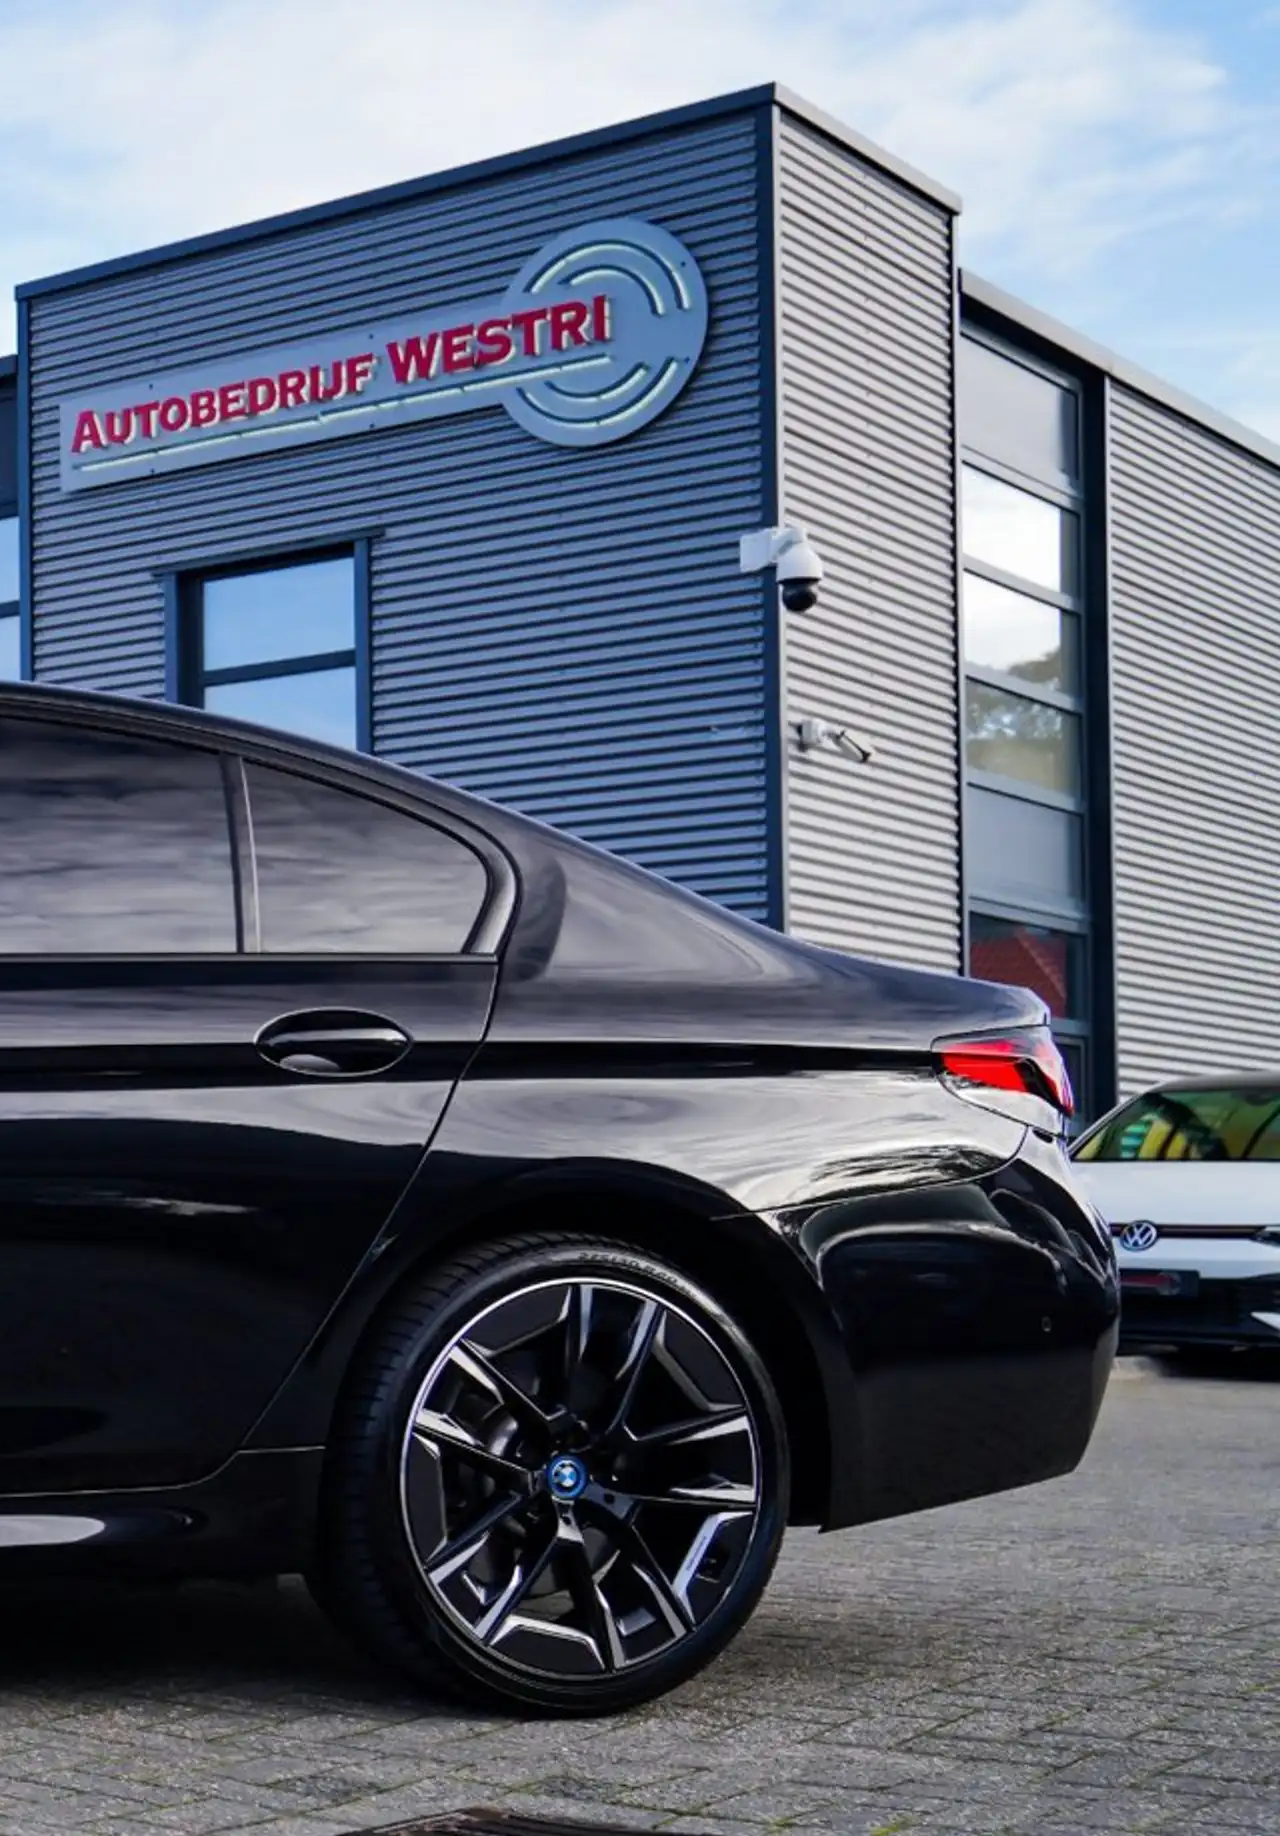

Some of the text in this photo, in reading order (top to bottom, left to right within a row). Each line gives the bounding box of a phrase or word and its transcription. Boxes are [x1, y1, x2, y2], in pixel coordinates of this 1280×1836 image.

[71, 294, 608, 453] AUTOBEDRIJF WESTRI
[1122, 1221, 1156, 1250] VW
